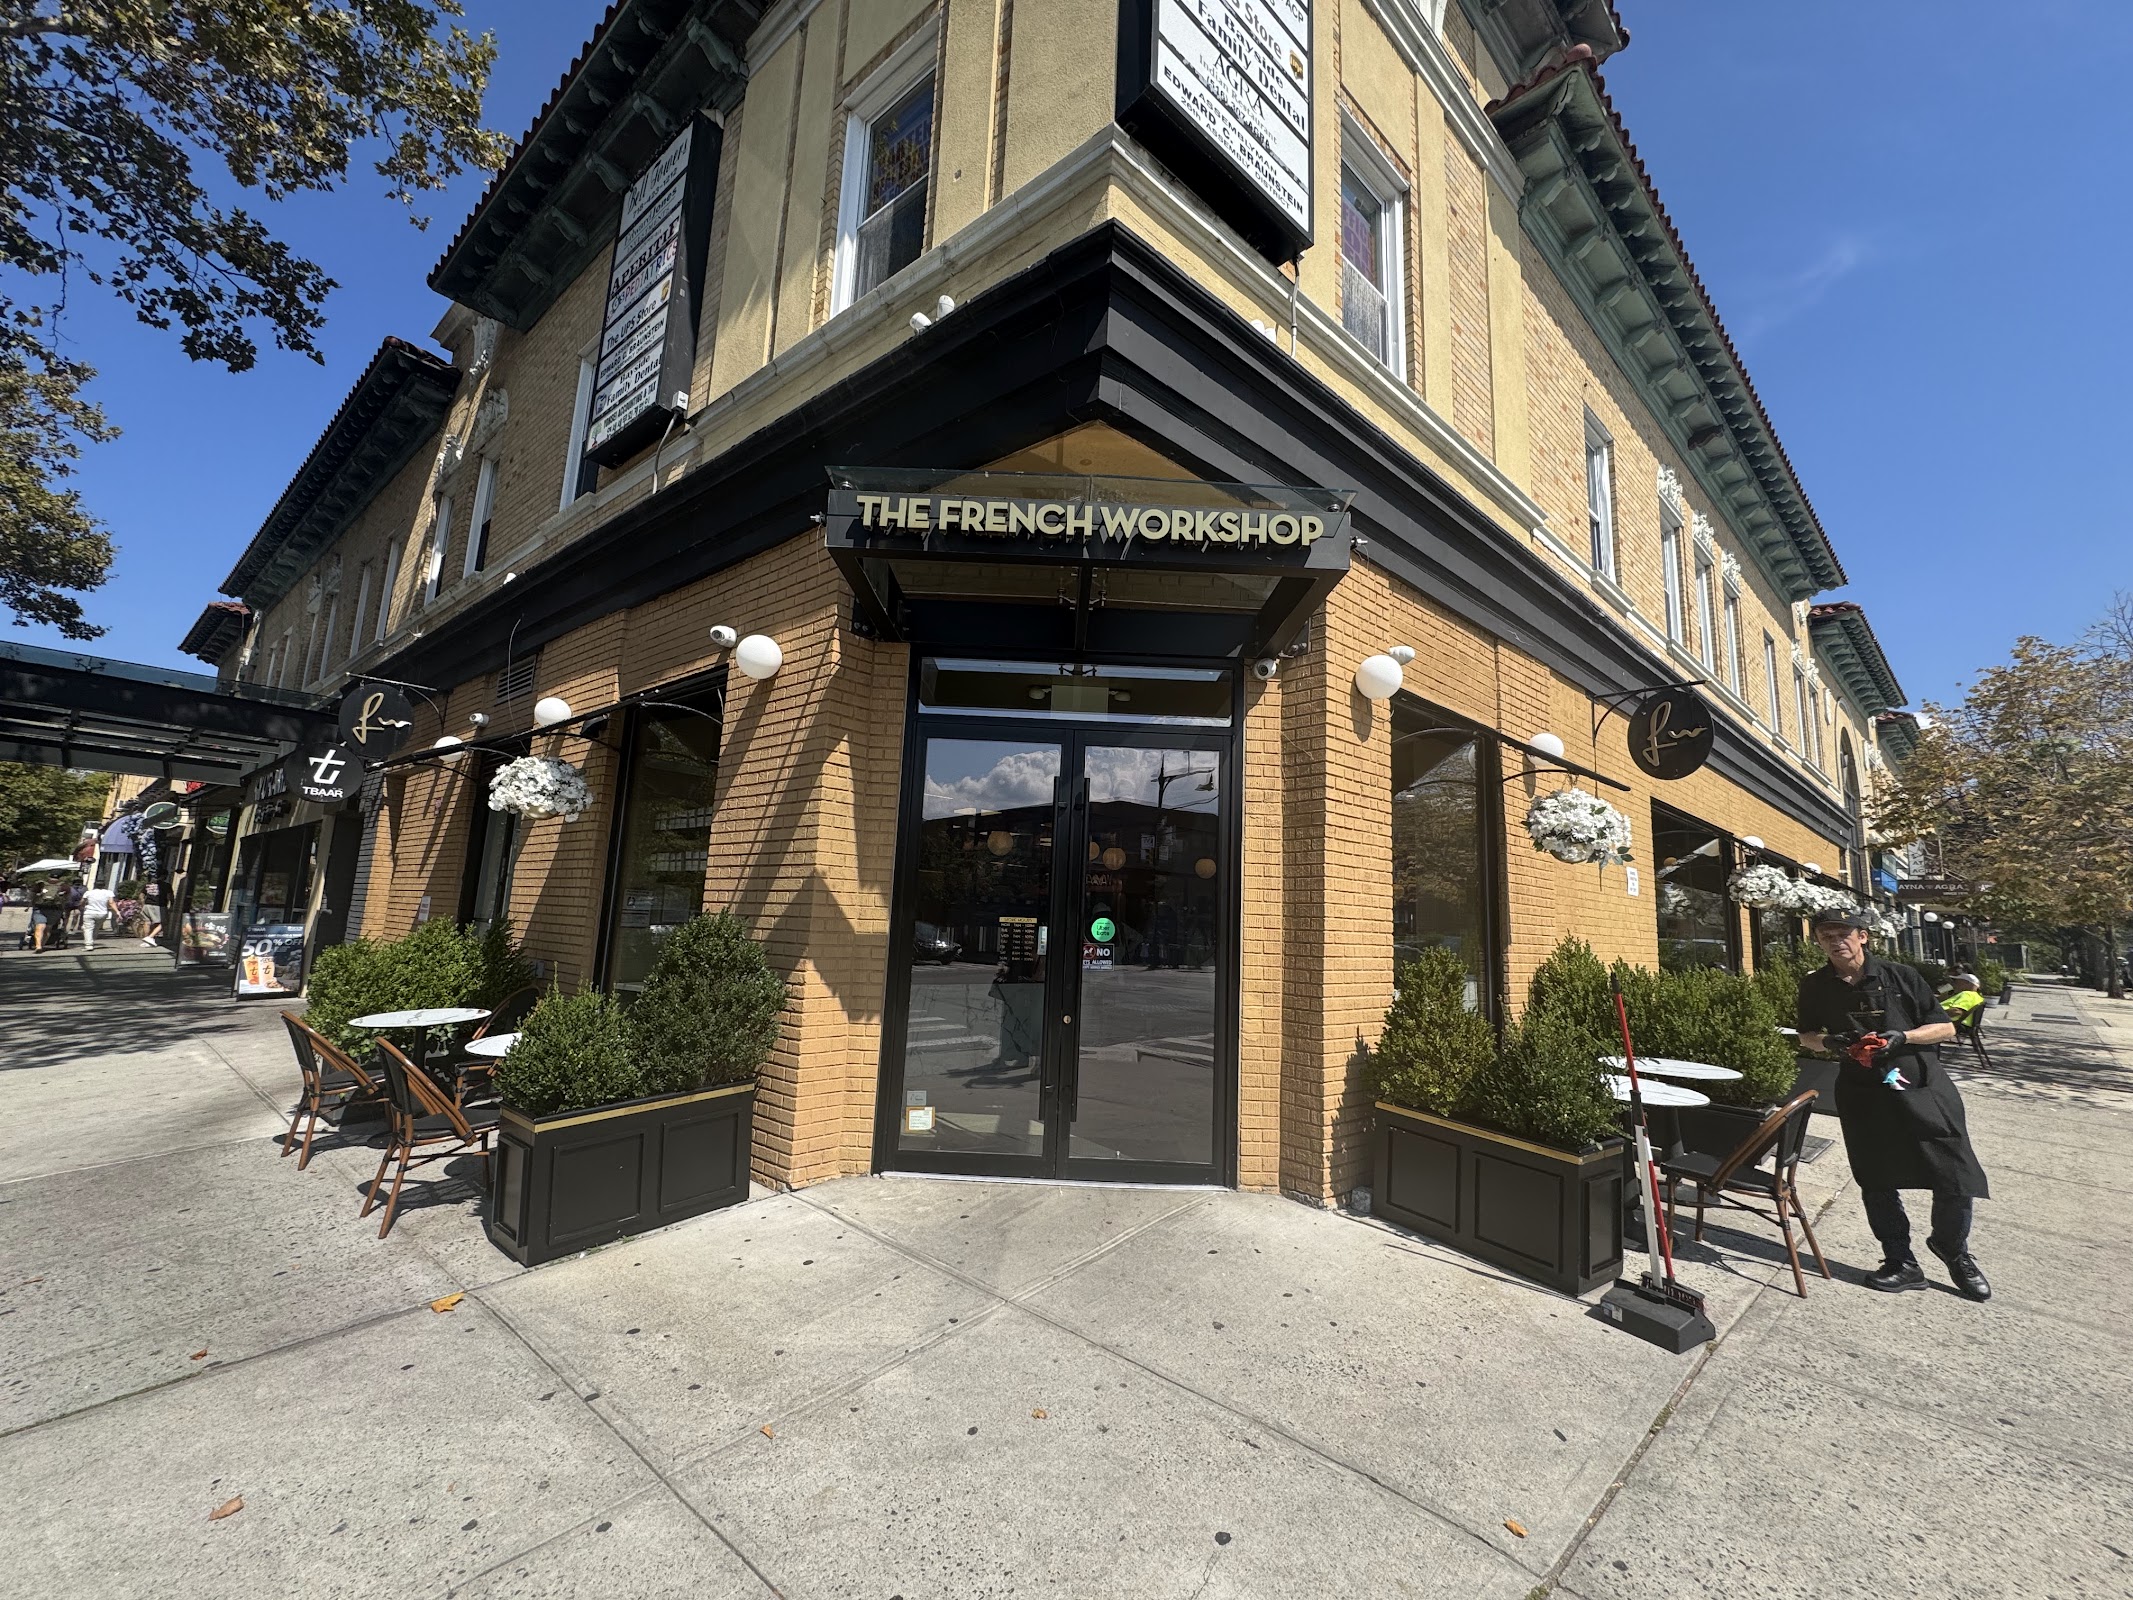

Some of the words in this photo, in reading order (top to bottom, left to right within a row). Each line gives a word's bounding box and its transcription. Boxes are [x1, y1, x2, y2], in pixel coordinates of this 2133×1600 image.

[1225, 13, 1283, 88] Bayside
[1245, 2, 1282, 60] Store
[1198, 0, 1251, 70] Family
[1259, 67, 1304, 132] Dental
[1213, 53, 1265, 120] AGRA
[1200, 54, 1228, 93] Indian
[1231, 89, 1277, 145] Restaurant
[1164, 65, 1216, 125] EDWARD
[1222, 127, 1234, 144] C.
[1240, 143, 1303, 214] BRAUNSTEIN
[1181, 96, 1201, 121] 26th
[1206, 123, 1250, 168] ASSEMBLY
[1255, 171, 1290, 208] DISTRICT
[1199, 93, 1277, 176] ASSEMBLYMAN
[611, 216, 679, 296] APERITIF
[625, 239, 677, 301] PEDIATRICS
[600, 355, 621, 378] EDWARD
[629, 318, 665, 354] BRAUNSTEIN
[607, 334, 619, 351] The
[621, 316, 636, 338] UPS
[637, 300, 657, 324] Store
[607, 381, 631, 406] Family
[634, 358, 661, 384] Dental
[620, 355, 651, 384] Bayside
[857, 495, 931, 529] THE
[938, 499, 1093, 536] FRENCH
[1100, 506, 1324, 546] WORKSHOP
[303, 786, 343, 798] TBAAR
[285, 938, 303, 946] OFF
[1096, 947, 1111, 957] NO
